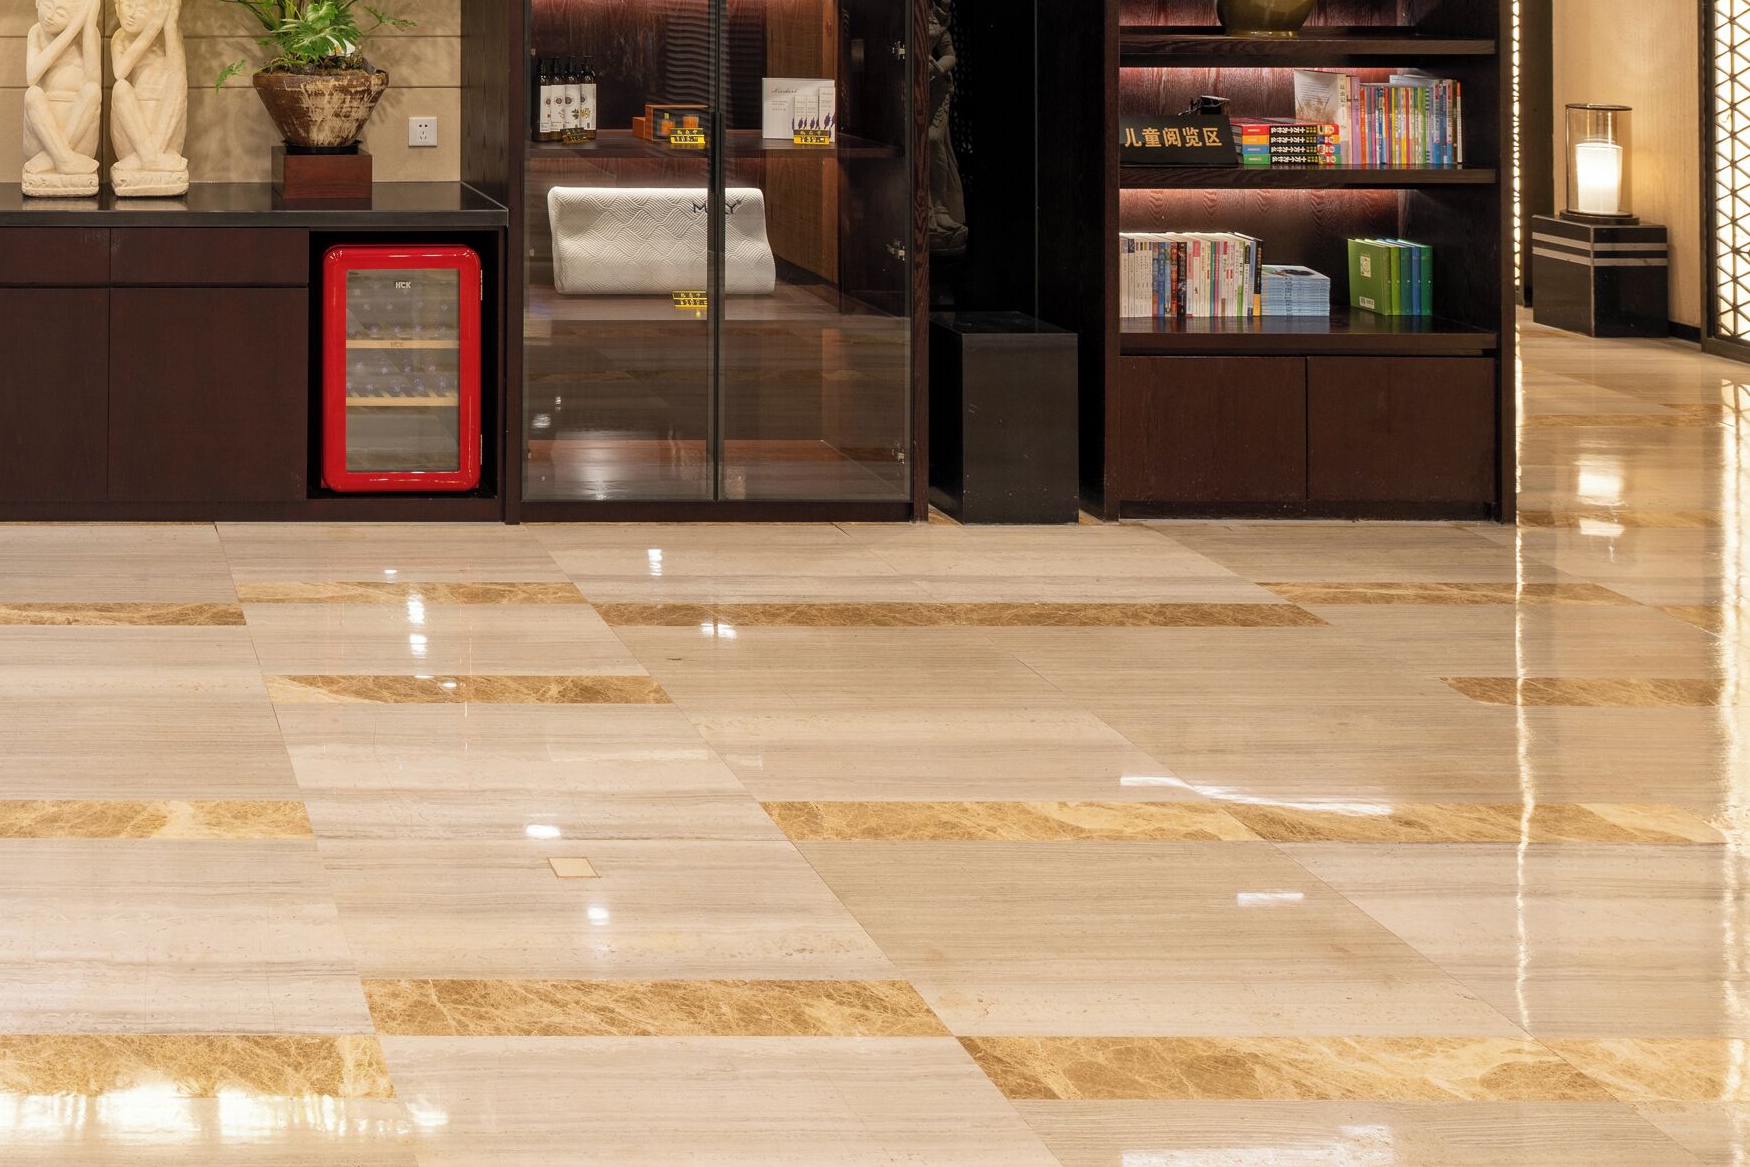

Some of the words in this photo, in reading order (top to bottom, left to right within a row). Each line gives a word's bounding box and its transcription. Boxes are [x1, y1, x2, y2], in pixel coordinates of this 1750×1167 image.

[1125, 127, 1222, 147] 儿童阅览区
